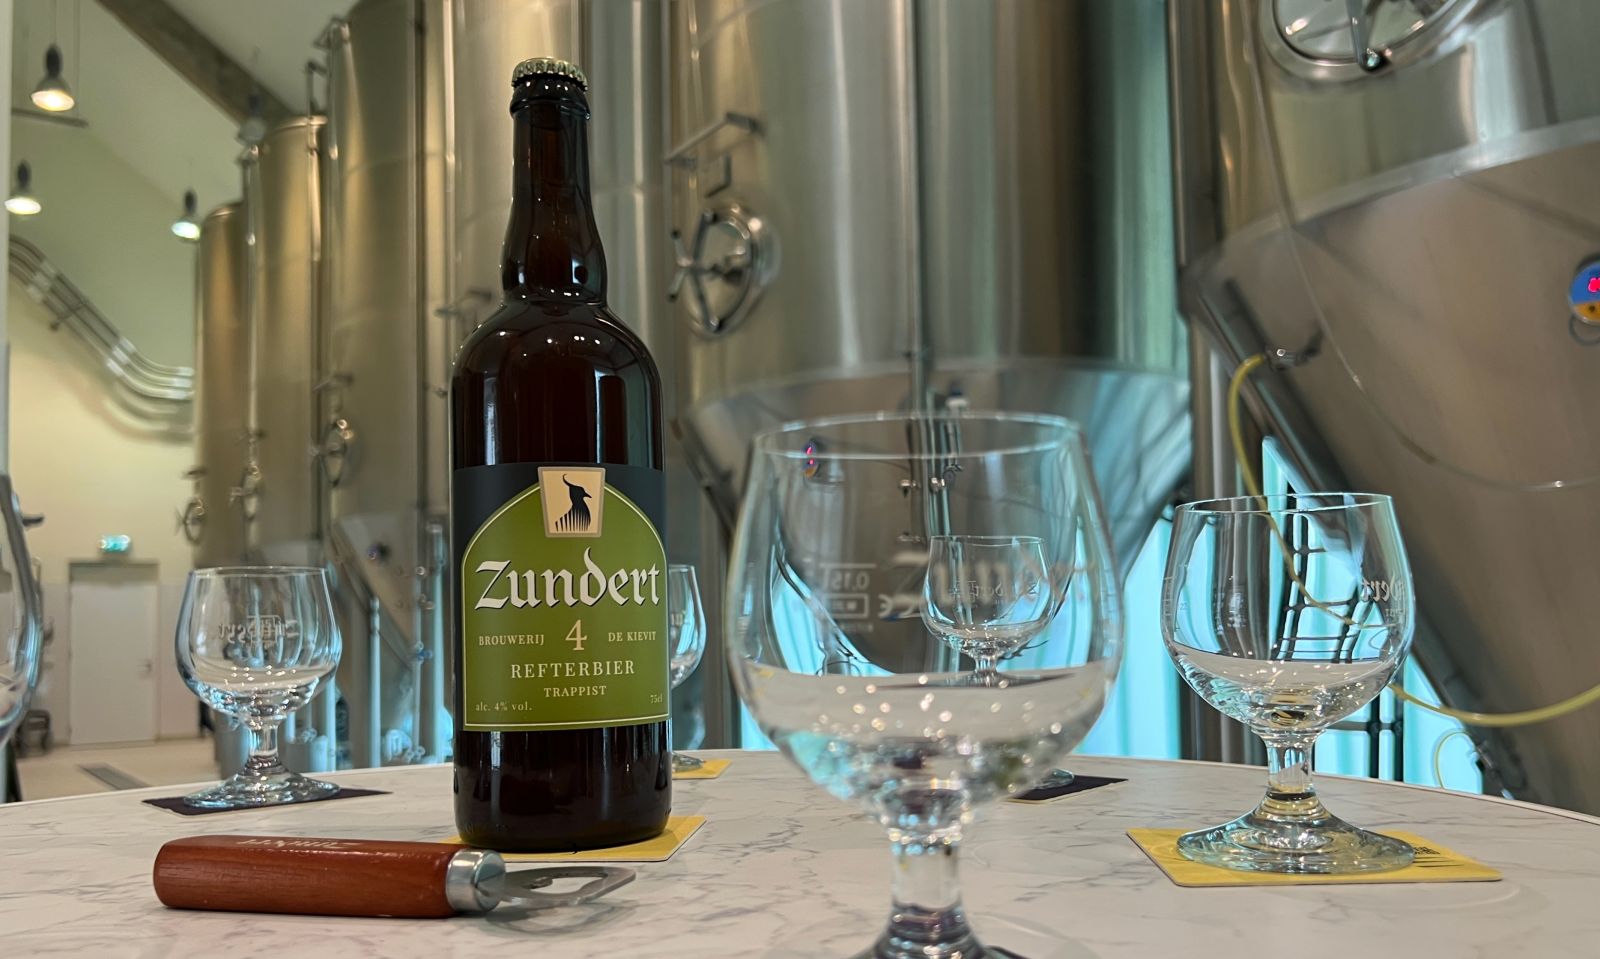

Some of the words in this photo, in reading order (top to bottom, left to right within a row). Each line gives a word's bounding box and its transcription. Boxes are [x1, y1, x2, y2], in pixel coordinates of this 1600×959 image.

[475, 547, 660, 610] Zundert
[478, 634, 544, 646] BROUWERIJ
[565, 619, 588, 651] 4
[608, 632, 623, 642] DE
[627, 631, 656, 641] KIEVIT
[511, 660, 635, 679] REFTERBIER
[543, 685, 607, 698] TRAPPIST
[650, 693, 663, 704] 75cl
[475, 701, 491, 712] alc.
[494, 701, 508, 711] 4%
[511, 701, 532, 711] vol.
